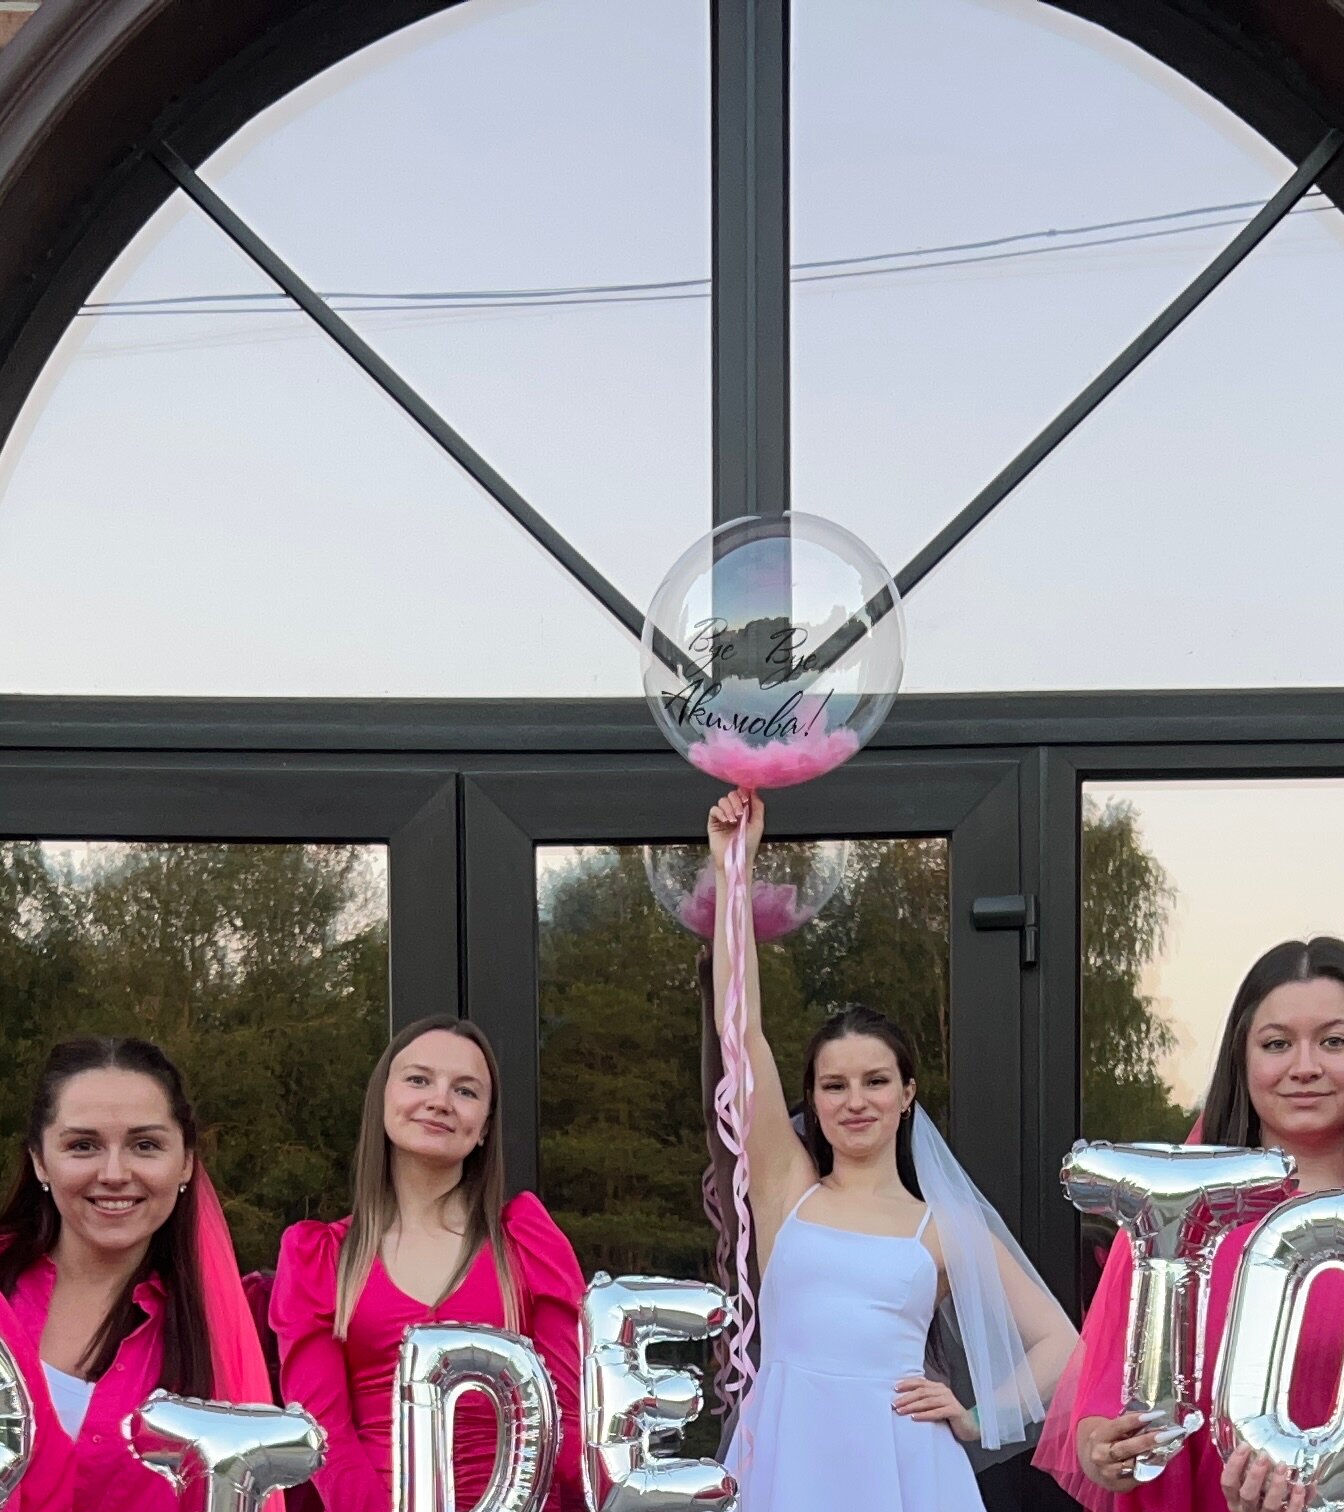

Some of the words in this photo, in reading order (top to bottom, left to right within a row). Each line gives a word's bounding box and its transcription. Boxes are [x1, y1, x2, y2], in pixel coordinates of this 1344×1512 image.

[684, 617, 737, 678] Bye
[760, 627, 818, 690] Bye
[661, 679, 834, 738] Акимова!
